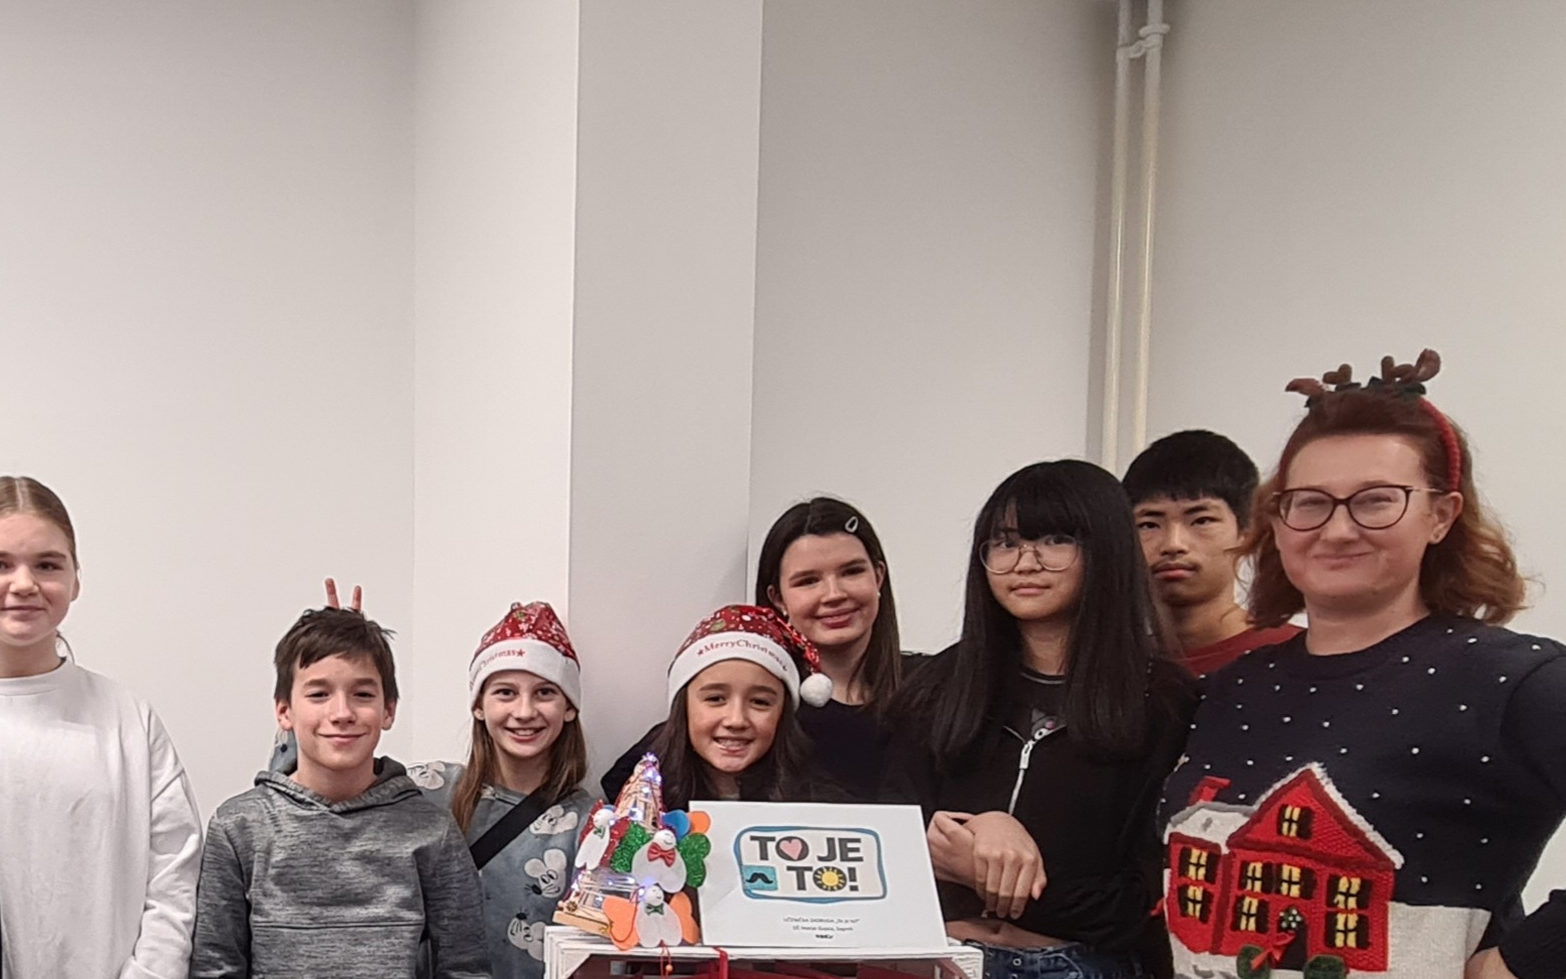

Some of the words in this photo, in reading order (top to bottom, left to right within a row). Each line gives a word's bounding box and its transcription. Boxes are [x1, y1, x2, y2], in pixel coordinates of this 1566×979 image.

[749, 835, 809, 862] TO
[816, 837, 864, 862] JE
[786, 865, 859, 892] TO!
